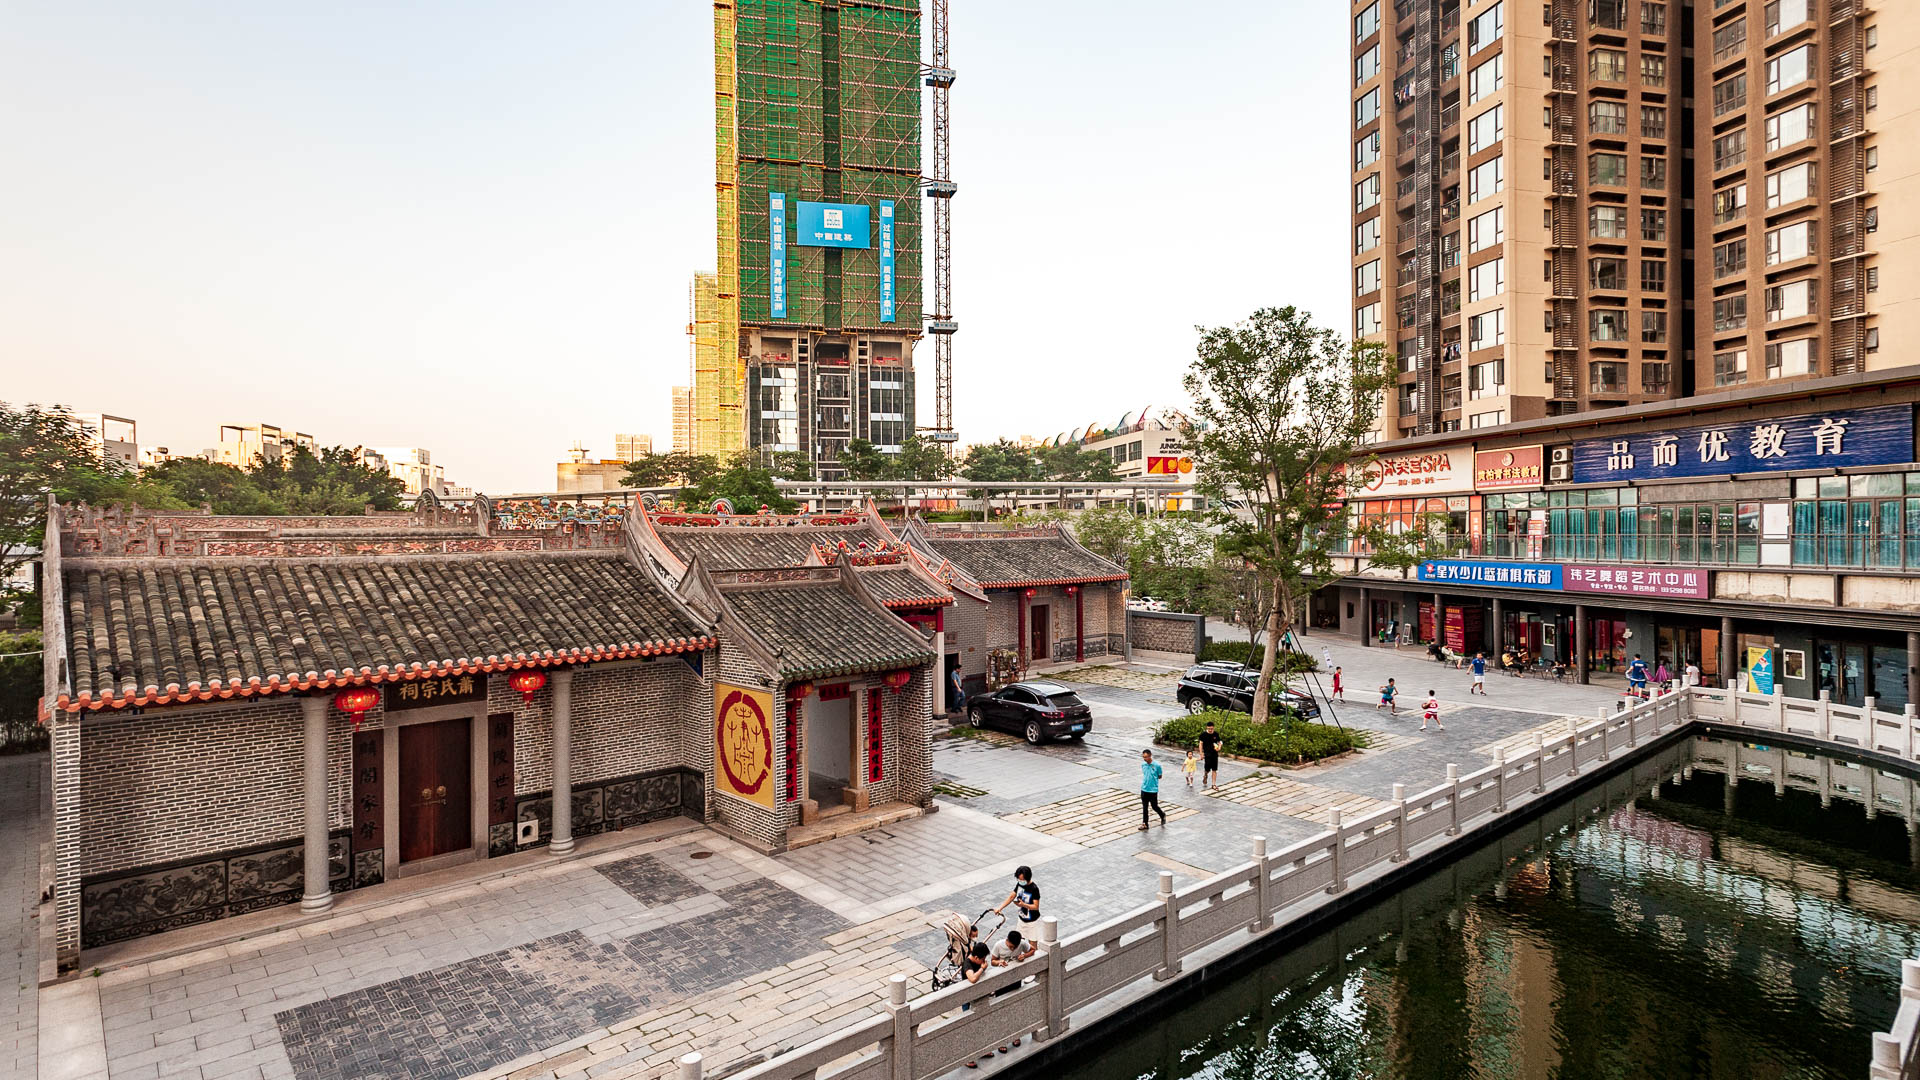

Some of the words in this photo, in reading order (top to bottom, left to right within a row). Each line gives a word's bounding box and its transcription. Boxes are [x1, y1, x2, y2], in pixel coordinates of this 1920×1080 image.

[1607, 418, 1851, 471] 品而优教育
[1437, 565, 1552, 584] 星火少儿篮球俱乐部
